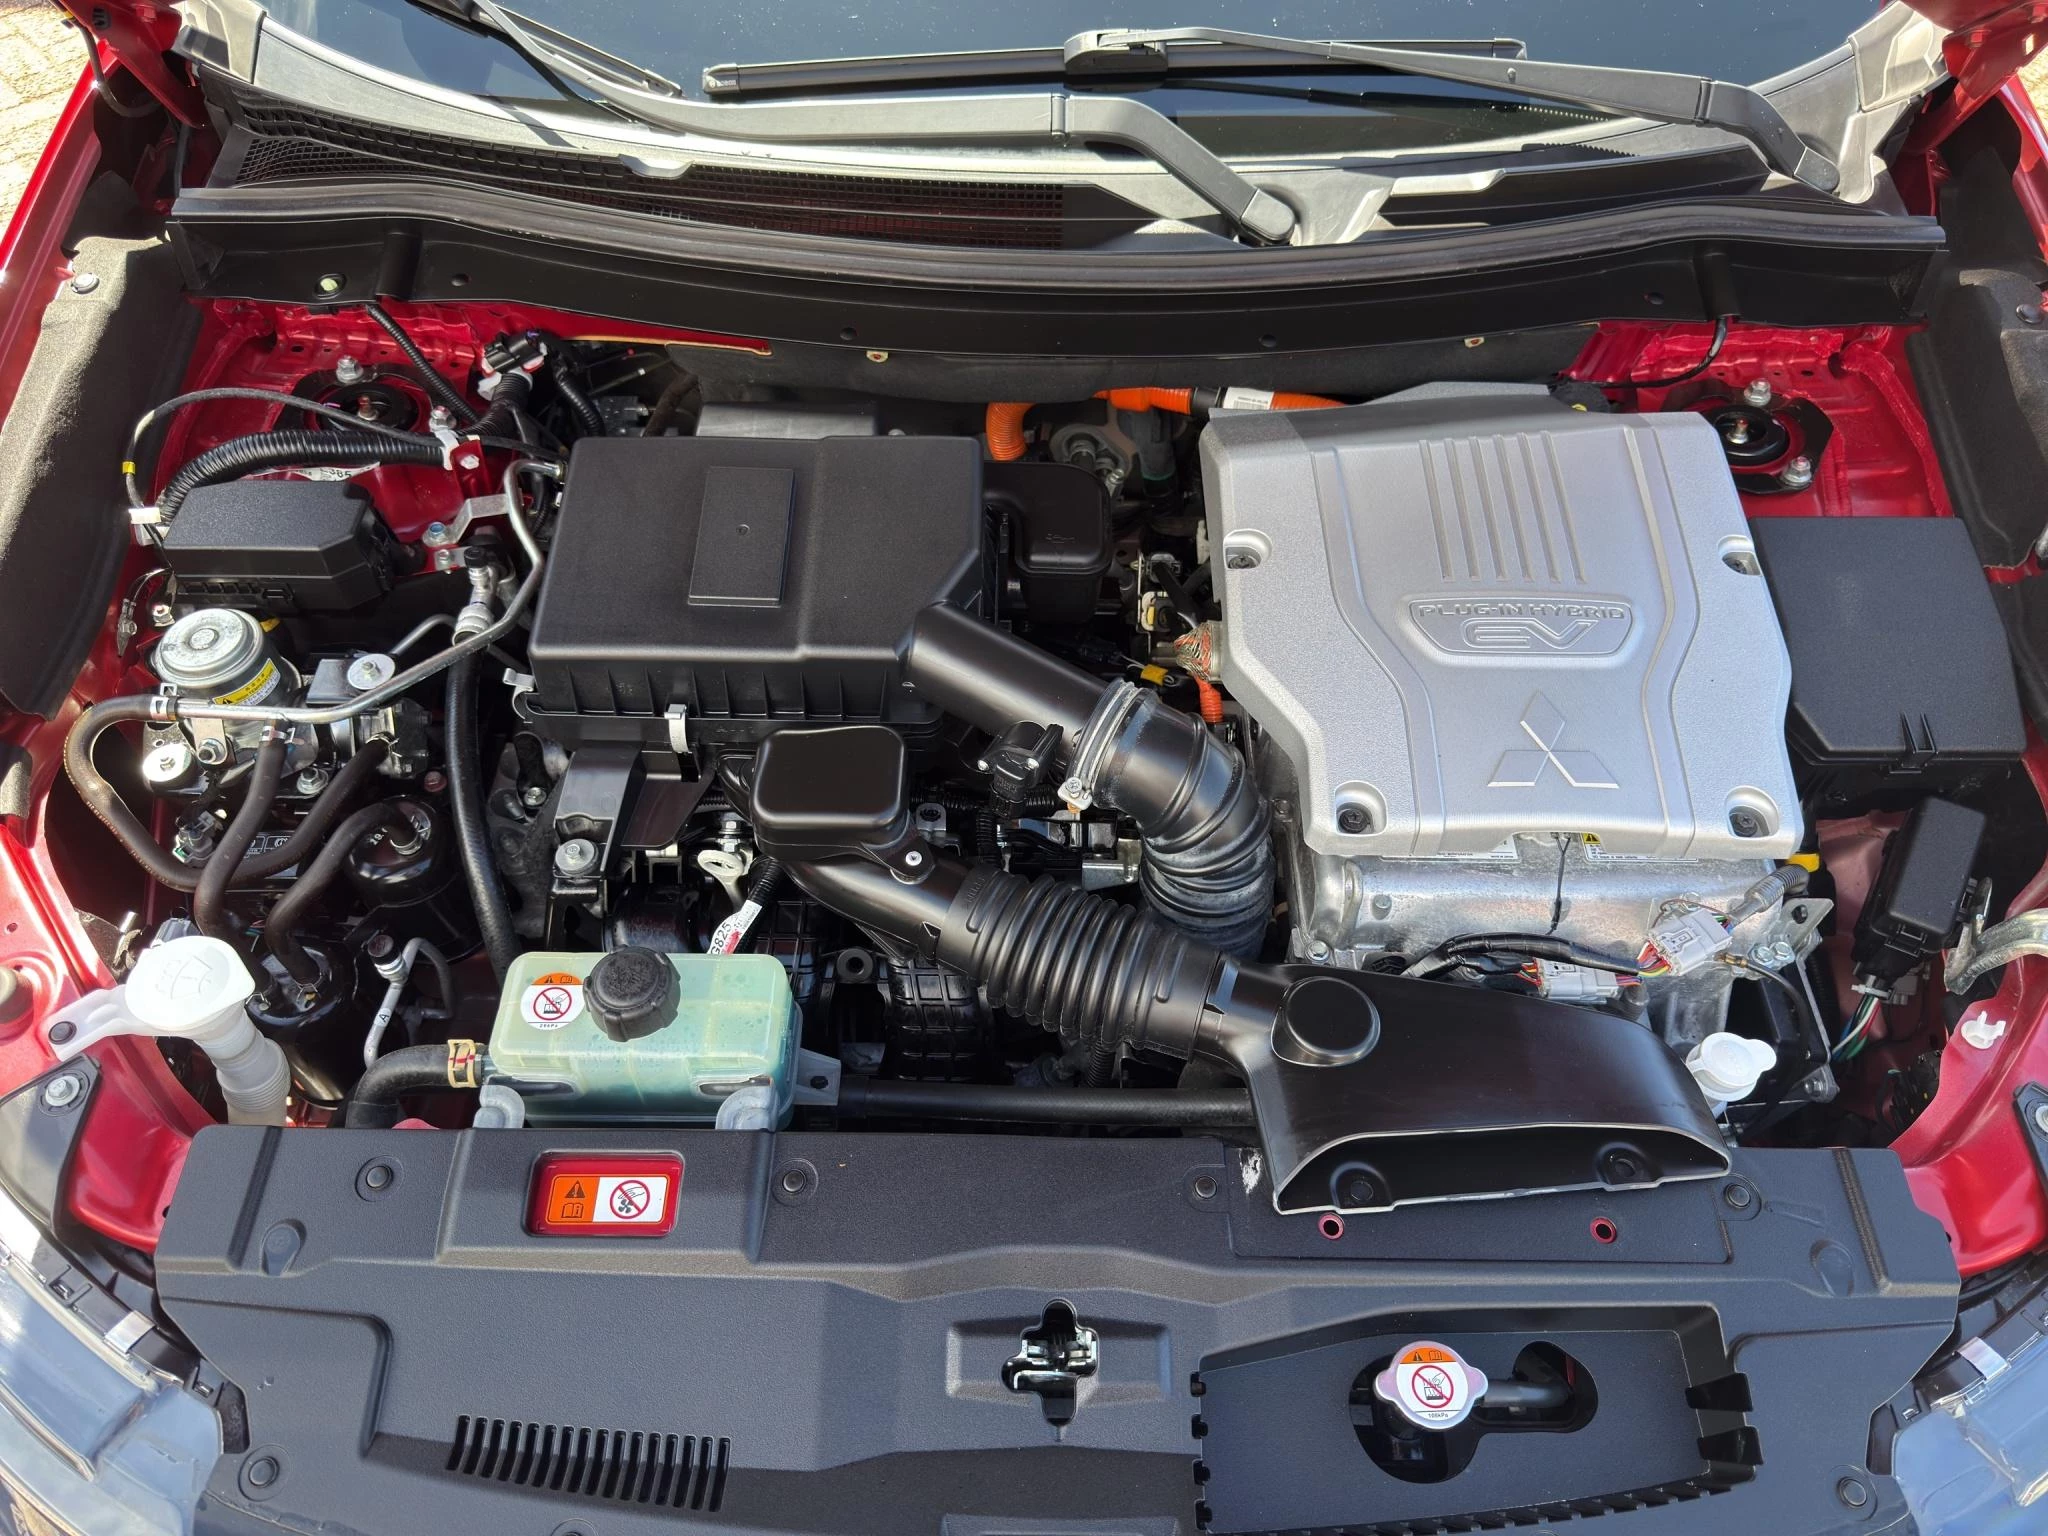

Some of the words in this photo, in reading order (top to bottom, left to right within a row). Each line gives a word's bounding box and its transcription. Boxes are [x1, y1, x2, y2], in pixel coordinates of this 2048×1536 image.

[1418, 602, 1523, 617] PLUG-IN
[1529, 603, 1625, 619] HYBRID
[1462, 617, 1599, 649] EV
